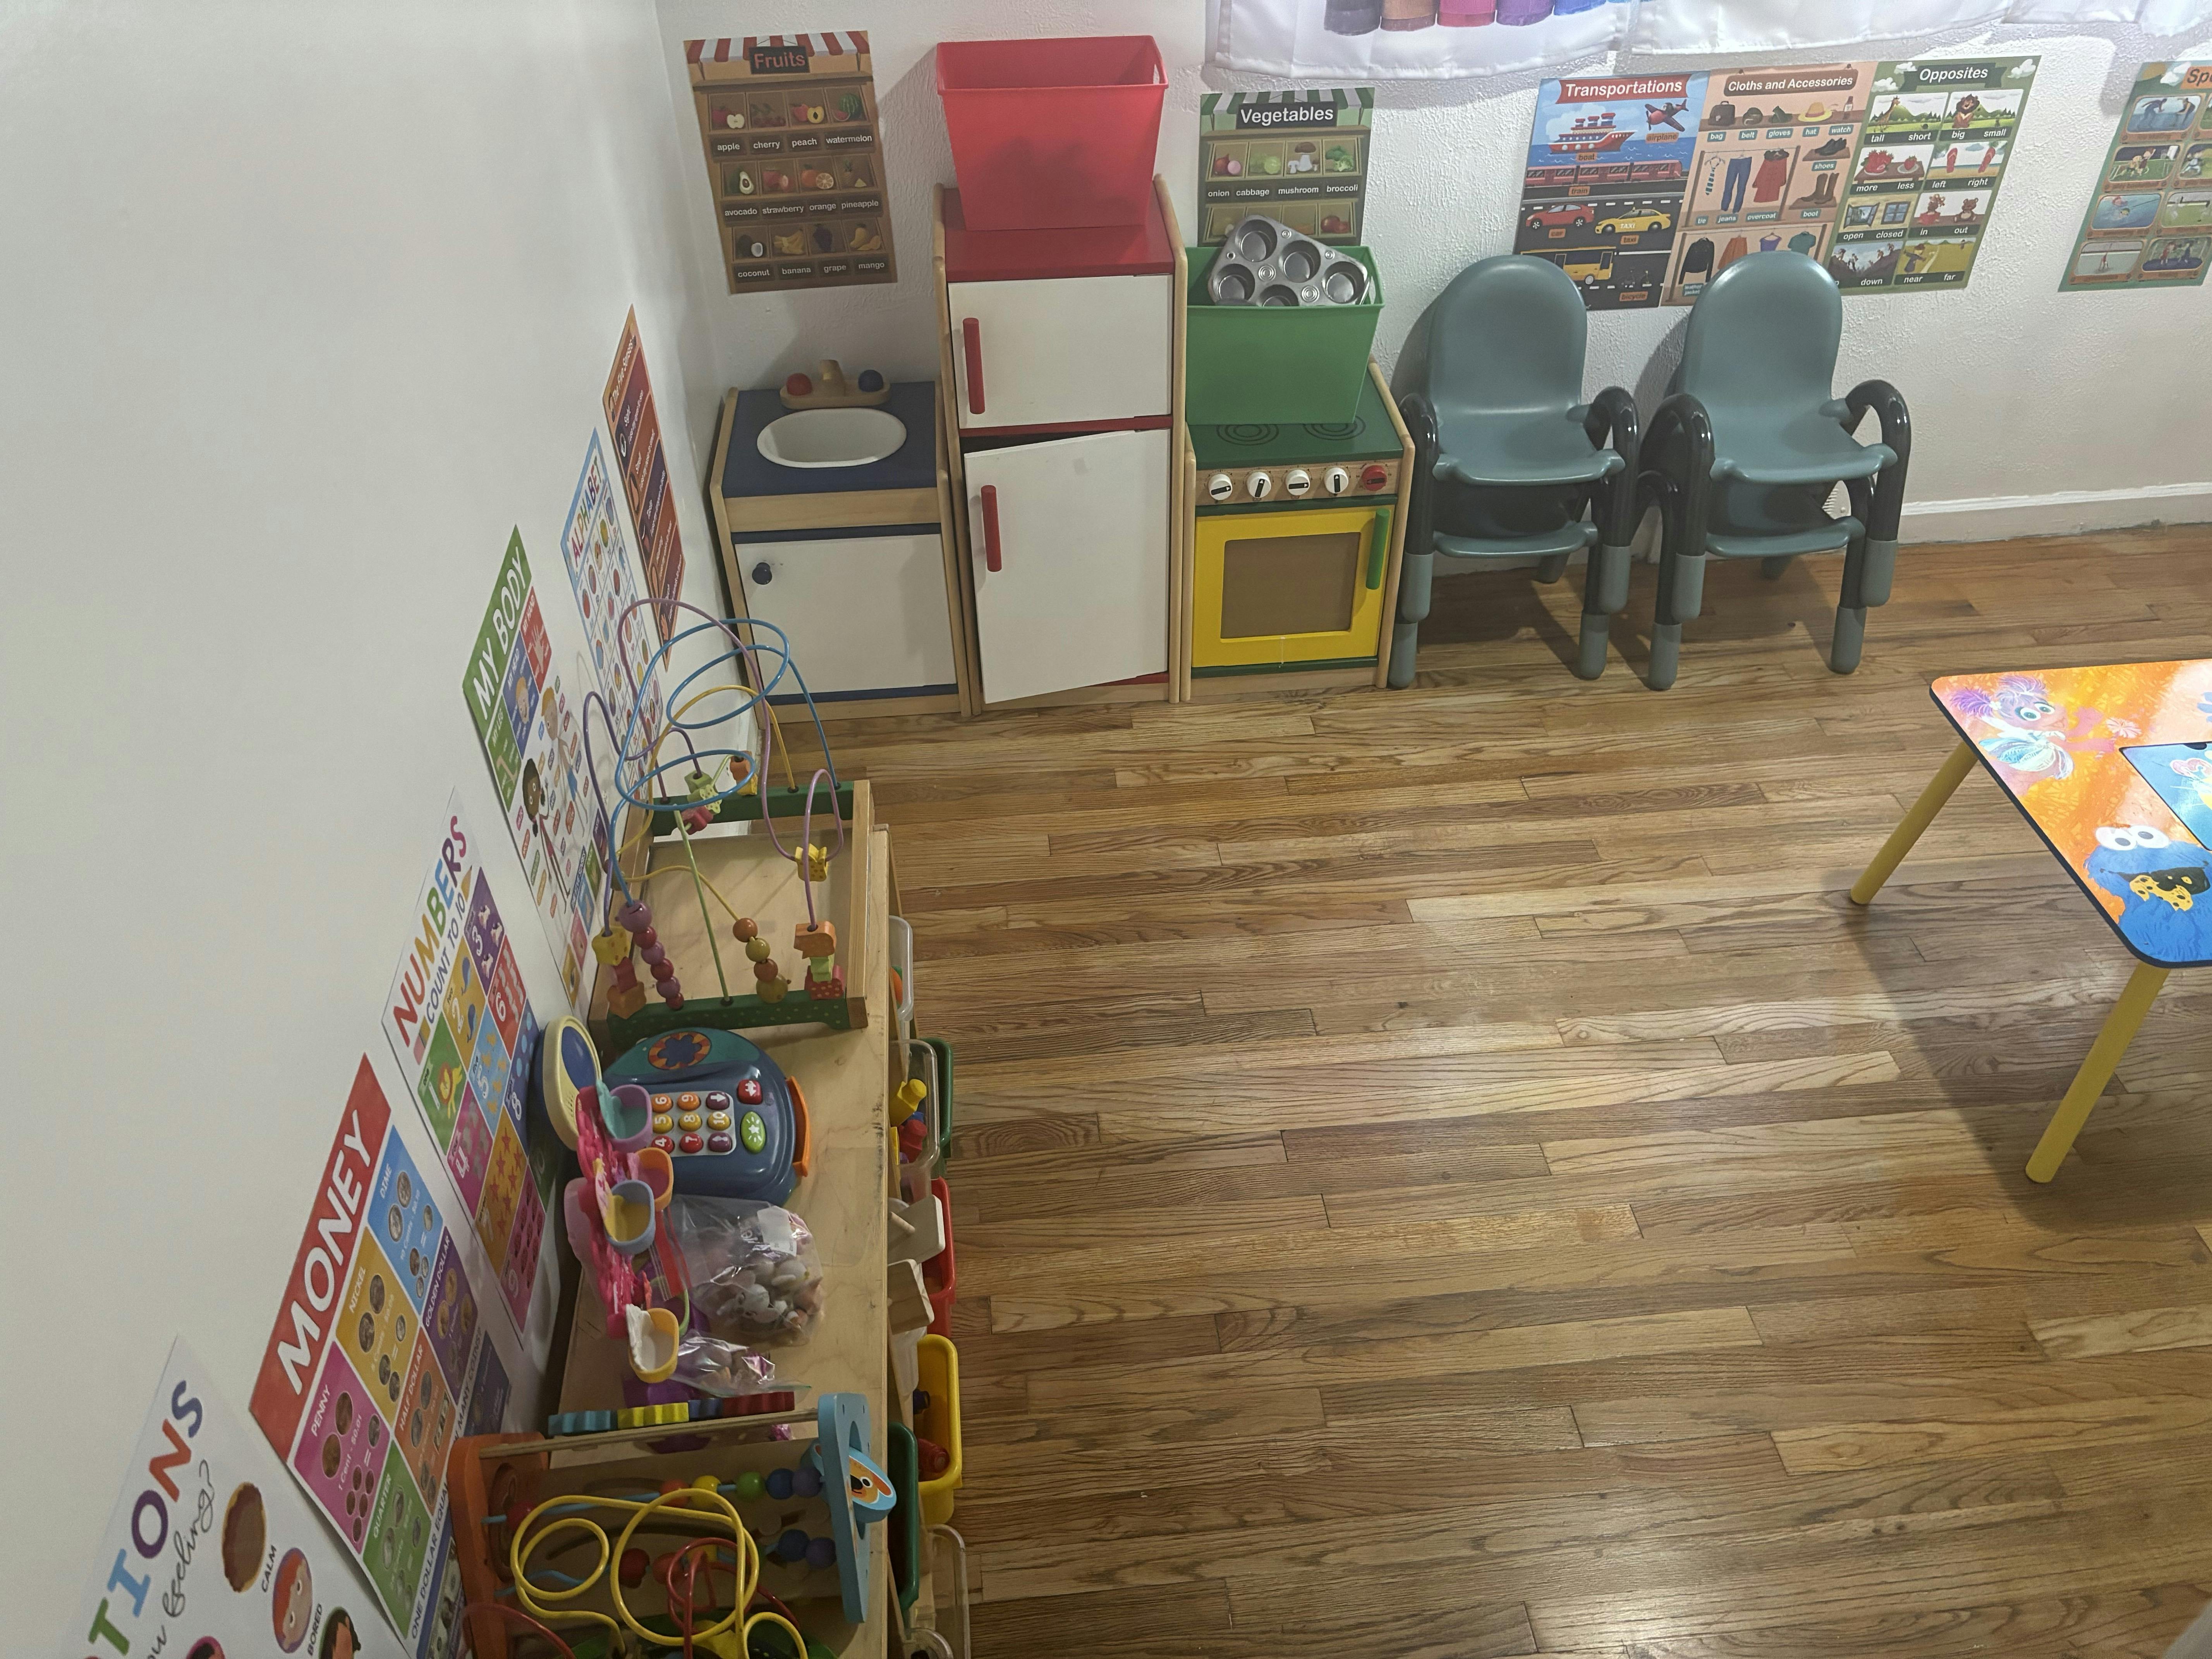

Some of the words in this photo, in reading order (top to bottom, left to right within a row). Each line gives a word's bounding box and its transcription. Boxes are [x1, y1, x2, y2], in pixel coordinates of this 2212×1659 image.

[754, 52, 805, 69] Fruits
[1920, 67, 1988, 83] Opposites
[1566, 81, 1682, 98] Transportations
[1728, 81, 1762, 91] Cloths
[1765, 80, 1784, 90] and
[1788, 77, 1853, 88] Accessories
[1241, 106, 1333, 126] Vegetables
[1769, 129, 1790, 137] gloves
[717, 143, 740, 151] apple
[754, 141, 780, 149] cherry
[792, 138, 817, 148] peach
[826, 135, 872, 144] watermelon
[1872, 135, 1884, 143] tall
[1952, 131, 1965, 139] big
[1968, 178, 1987, 187] right
[725, 208, 757, 216] avocado
[763, 205, 804, 214] strawberry
[809, 203, 836, 211] orange
[842, 200, 878, 209] pineapple
[738, 270, 769, 278] coconut
[782, 266, 811, 275] banana
[824, 264, 846, 273] grape
[859, 262, 884, 270] mango
[571, 457, 601, 566] ALPHABET
[473, 637, 499, 720] MY
[493, 546, 526, 654] BODY
[393, 815, 467, 1048] NUMBERS
[471, 924, 483, 958] 3
[426, 949, 451, 1024] COUNT
[448, 917, 458, 948] TO
[456, 890, 465, 920] 10
[451, 997, 464, 1033] 2
[495, 990, 507, 1024] 6
[428, 1080, 440, 1111] 1
[476, 1065, 489, 1099] 5
[511, 1089, 522, 1121] 8
[713, 1111, 725, 1125] 10
[655, 1138, 666, 1147] 4
[455, 1144, 469, 1181] 4
[380, 1163, 392, 1199] DIME
[277, 1109, 371, 1395] MONEY
[350, 1263, 365, 1314] NICKEL
[426, 1279, 439, 1328] GOLDEN
[437, 1234, 450, 1280] DOLLAR
[507, 1267, 520, 1298] 9
[400, 1393, 410, 1432] HALF
[409, 1348, 421, 1396] DOLLAR
[458, 1381, 469, 1429] MANY
[312, 1384, 330, 1437] PENNY
[341, 1453, 351, 1486] Cent
[373, 1472, 391, 1540] QUARTER
[163, 1460, 215, 1617] feeling?
[262, 1546, 277, 1593] CALM
[412, 1600, 422, 1640] ONE
[421, 1531, 437, 1599] DOLLAR
[308, 1603, 323, 1656] BORED
